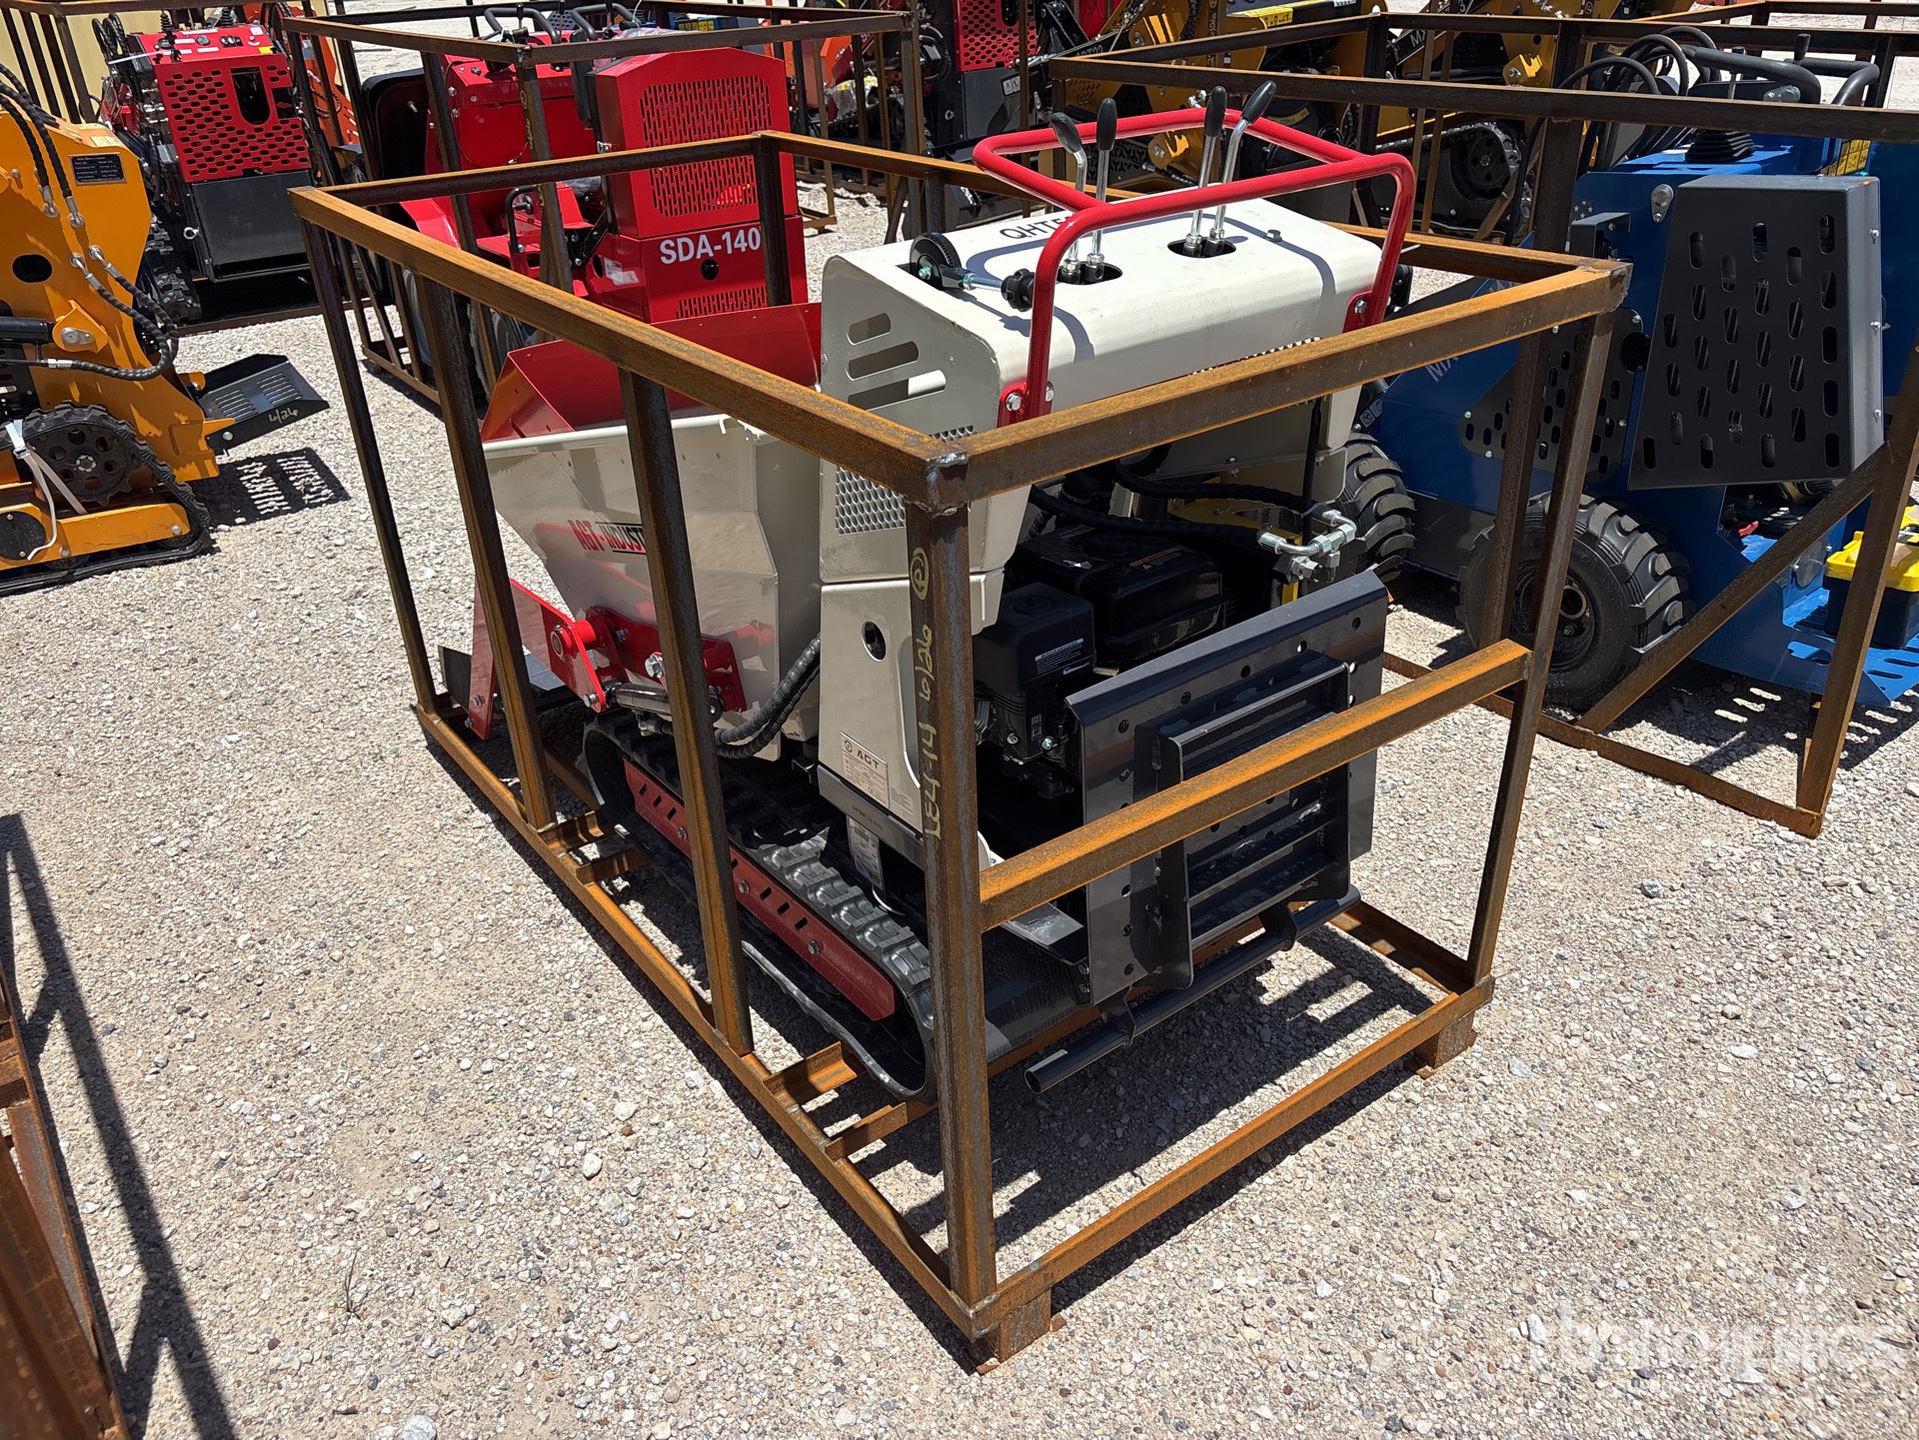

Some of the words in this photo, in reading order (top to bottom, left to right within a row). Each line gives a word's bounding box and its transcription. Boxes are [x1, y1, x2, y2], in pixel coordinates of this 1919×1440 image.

[659, 227, 761, 264] SDA-140
[268, 407, 299, 424] 6/26
[857, 750, 880, 769] AGT
